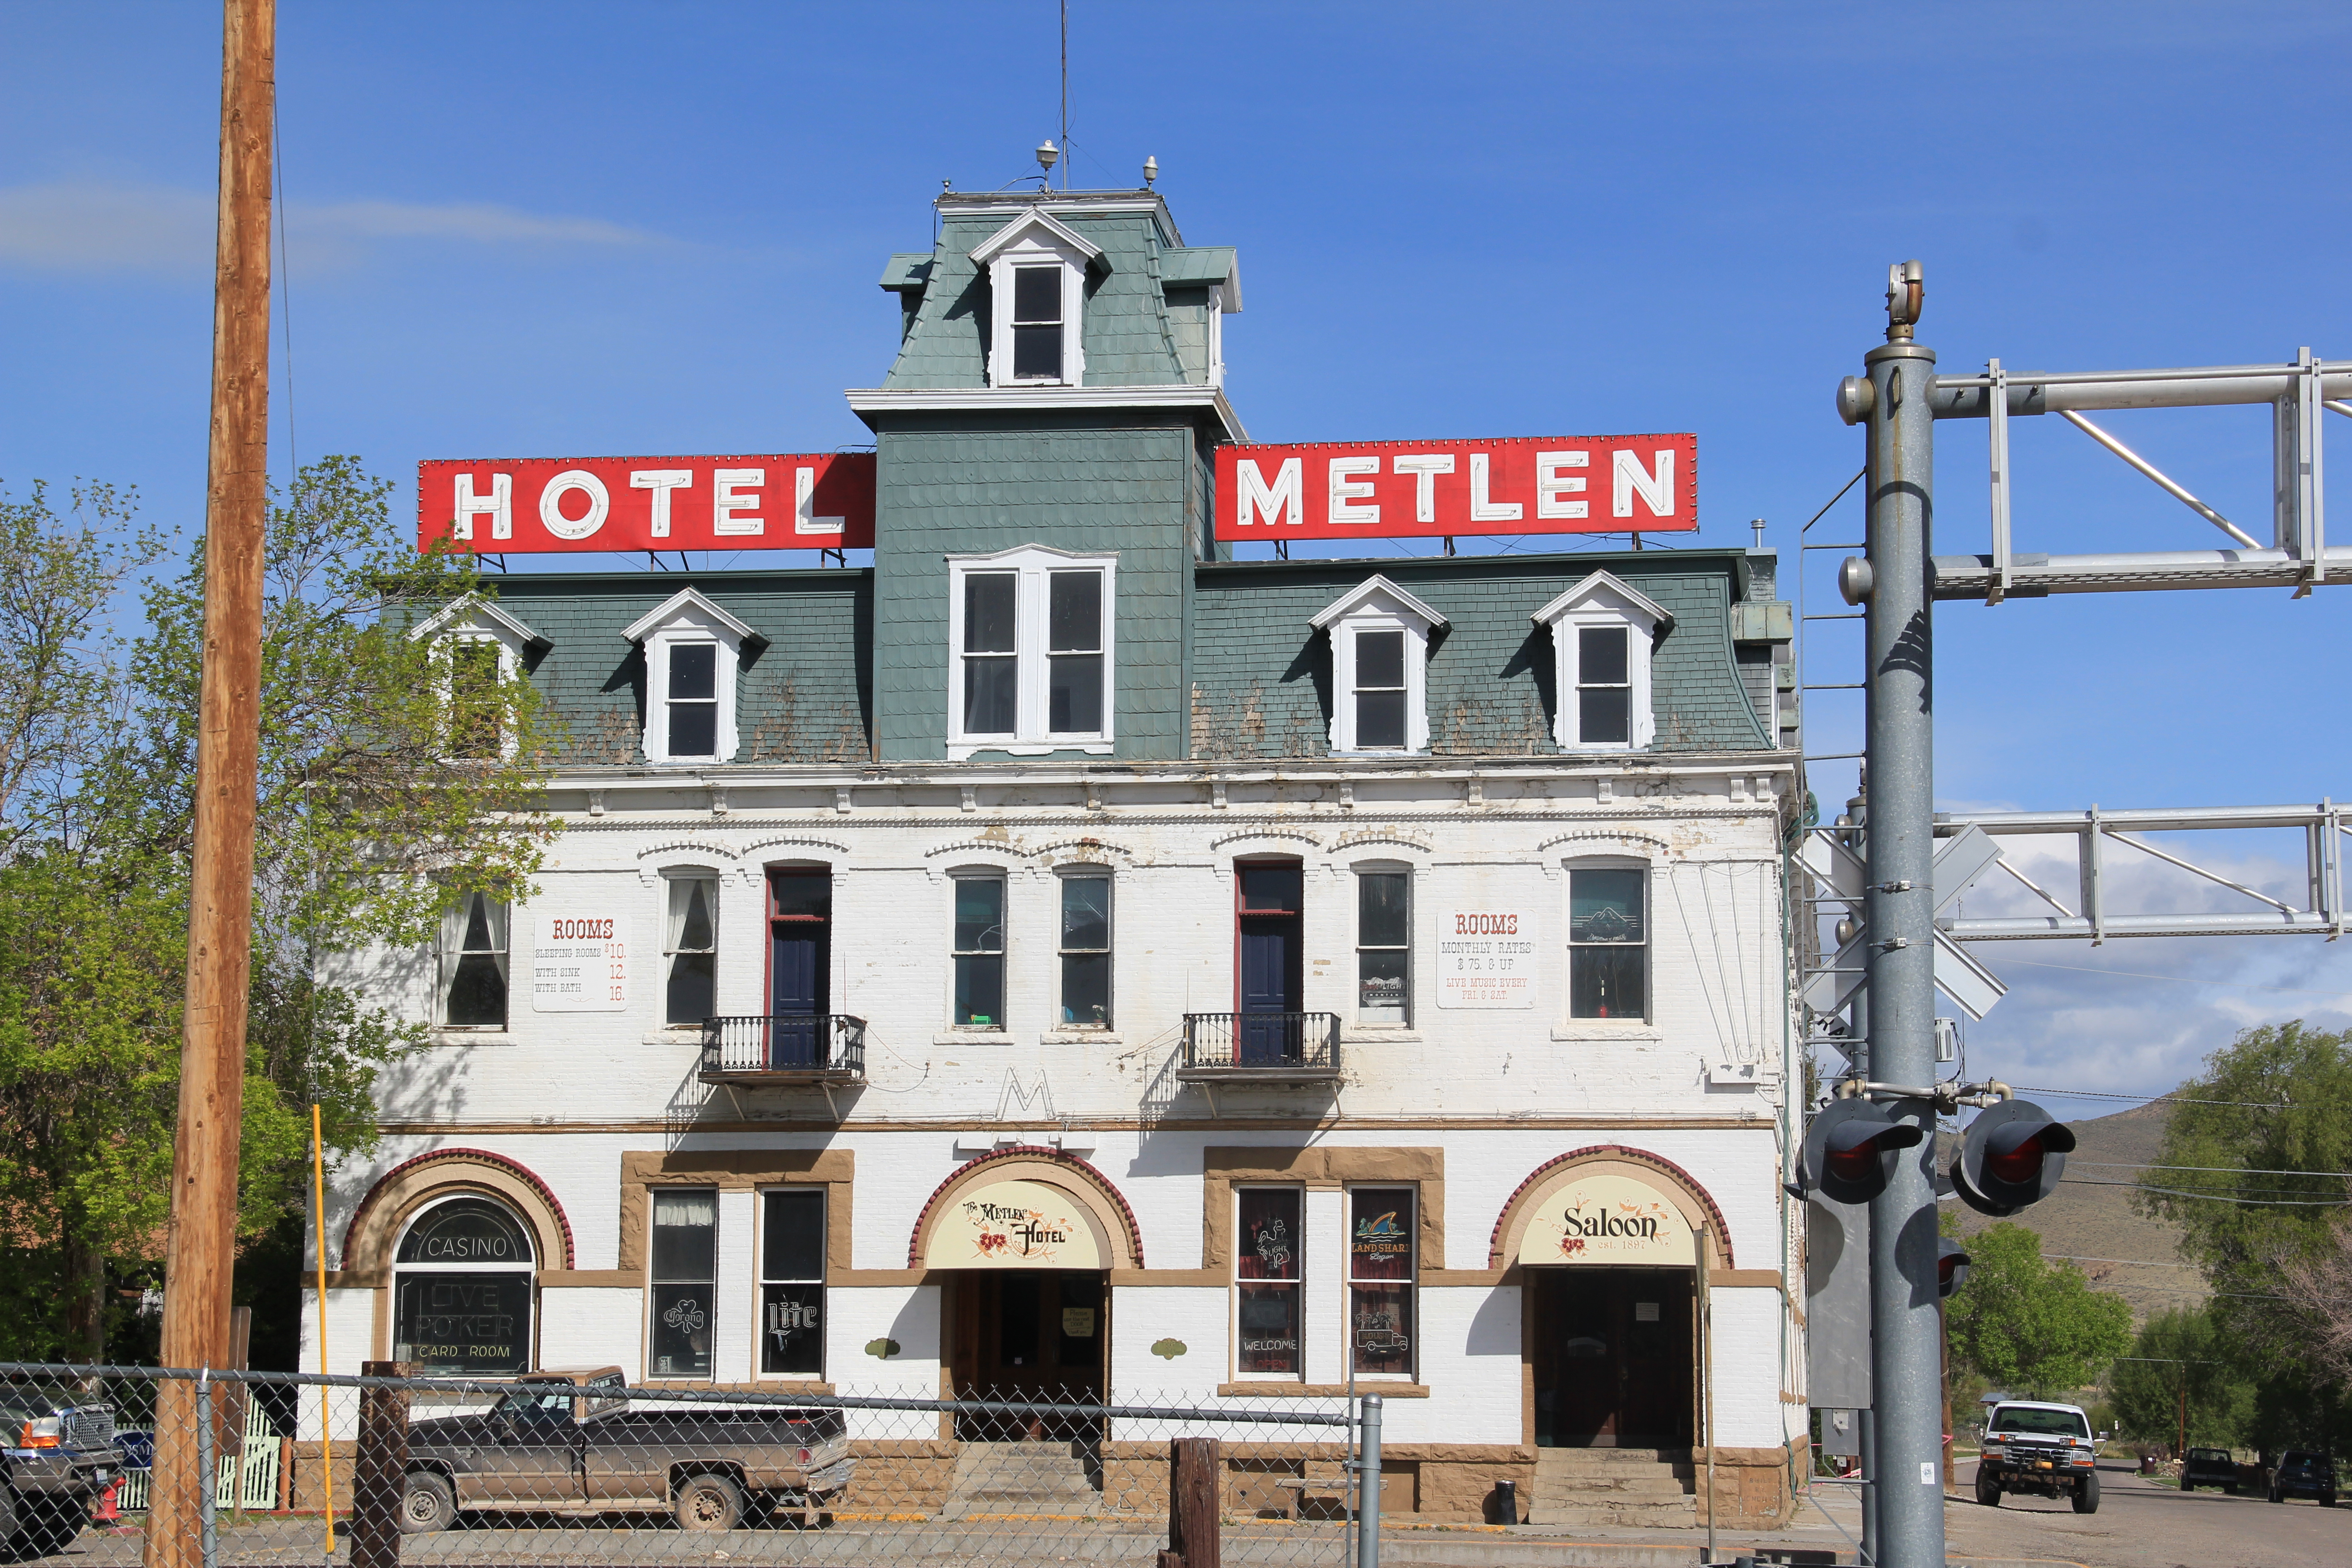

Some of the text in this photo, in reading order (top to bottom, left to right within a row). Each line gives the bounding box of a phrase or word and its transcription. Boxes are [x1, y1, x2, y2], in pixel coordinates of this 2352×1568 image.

[1237, 449, 1674, 525] METLEN
[454, 467, 845, 540] HOTEL
[553, 919, 613, 939] ROOMS
[1455, 914, 1518, 935] ROOMS
[535, 949, 573, 958] SLEEPING
[576, 948, 601, 957] ROOMS
[1441, 942, 1531, 953] MONTHLY RATES
[1489, 958, 1494, 970] &
[1499, 959, 1514, 970] UP
[535, 964, 626, 979] WITH SINK 12.
[1446, 978, 1527, 987] LIVE MUSIC EVERY
[535, 983, 625, 1000] WITH BATH 16.
[1462, 990, 1507, 1000] FRI. & SAT.
[963, 1201, 1029, 1225] The METLEN
[1564, 1208, 1656, 1243] Saloon
[1010, 1220, 1066, 1256] HOTEL
[1597, 1240, 1646, 1250] est. 1897
[428, 1238, 506, 1256] CASINO
[1269, 1245, 1287, 1256] LIGHT
[1370, 1252, 1394, 1262] Lager
[664, 1309, 701, 1323] Corona
[768, 1302, 817, 1335] Lite
[416, 1316, 513, 1337] POKER
[419, 1346, 510, 1357] CARD ROOM
[1245, 1340, 1298, 1351] WELCOME
[1257, 1360, 1287, 1369] OPEN
